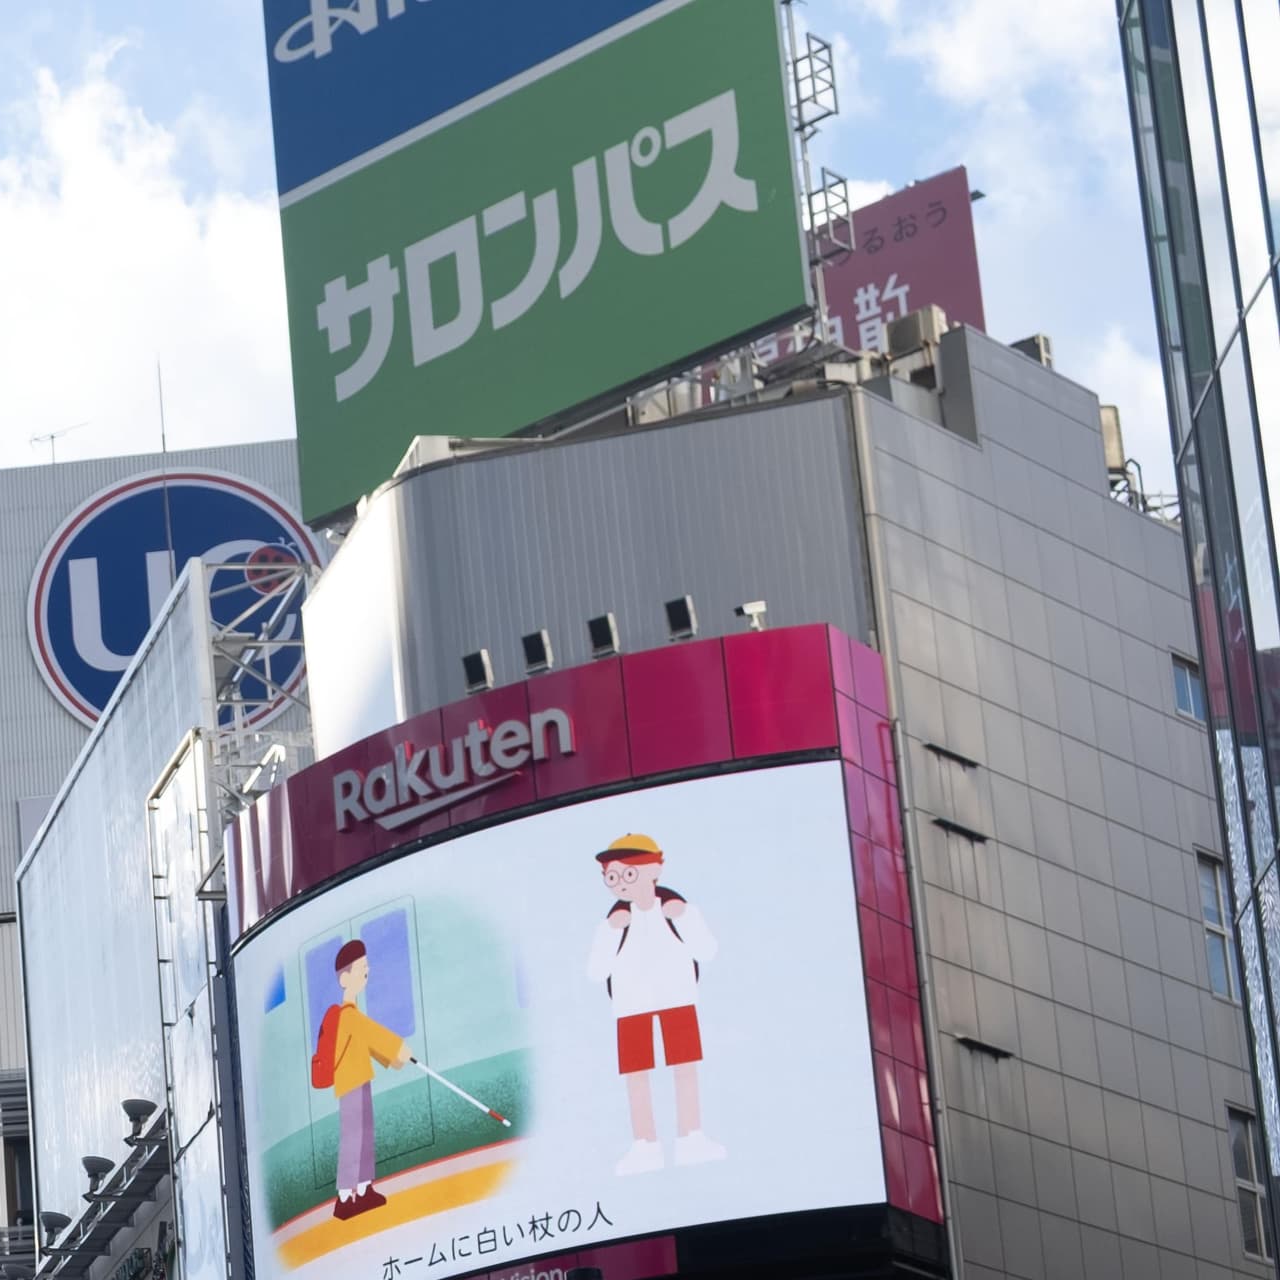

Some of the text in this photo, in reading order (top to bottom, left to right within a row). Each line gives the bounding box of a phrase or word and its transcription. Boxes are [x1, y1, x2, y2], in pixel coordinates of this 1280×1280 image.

[316, 88, 758, 402] サロンパス
[332, 705, 578, 832] Rakuten
